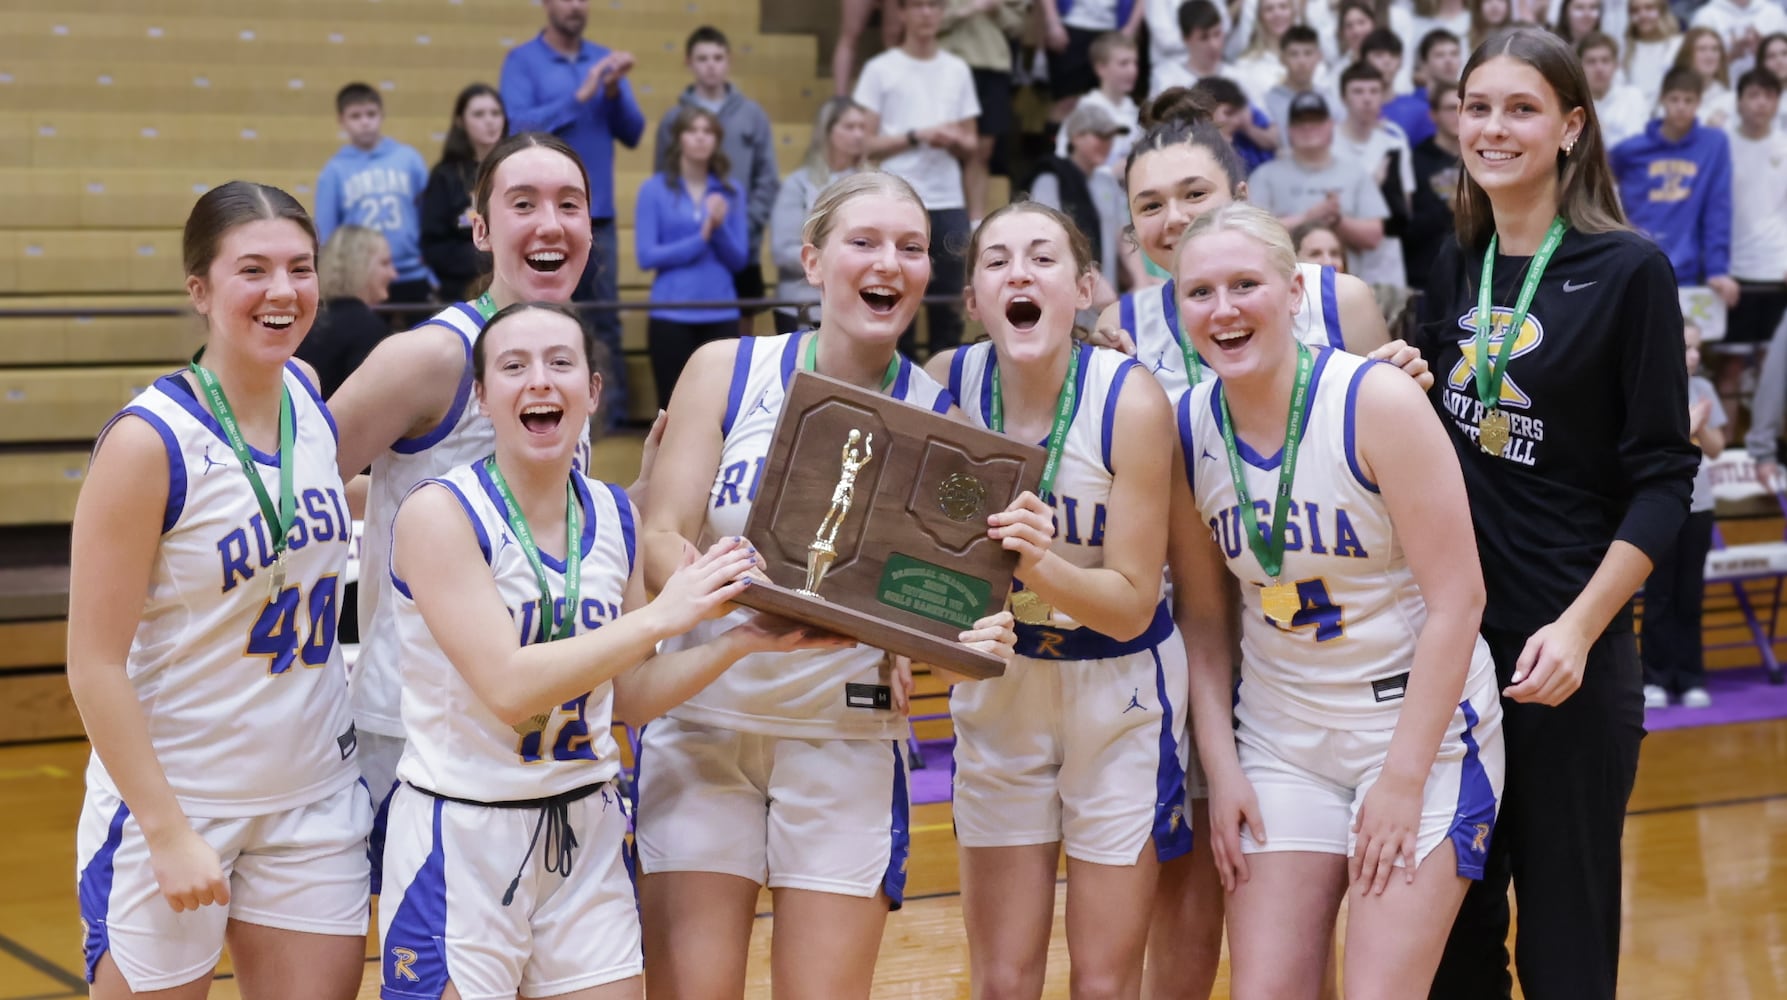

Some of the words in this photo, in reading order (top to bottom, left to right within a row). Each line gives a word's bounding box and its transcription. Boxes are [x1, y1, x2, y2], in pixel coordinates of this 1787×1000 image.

[361, 193, 402, 231] 23
[1448, 306, 1544, 410] R
[210, 389, 229, 415] ATHLETIC
[223, 416, 246, 453] ASSOCIATION
[1053, 419, 1066, 445] ATHLETIC
[1289, 410, 1299, 437] ATHLETIC
[1471, 400, 1544, 442] RDERS
[1043, 446, 1059, 482] ASSOCIATION
[1284, 438, 1295, 475] ASSOCIATION
[516, 520, 530, 546] ATHLETIC
[242, 572, 340, 678] 40
[913, 599, 974, 624] BASKETBALL
[1250, 576, 1347, 642] 4
[1036, 631, 1065, 657] R
[1471, 823, 1490, 854] R
[391, 946, 420, 981] R
